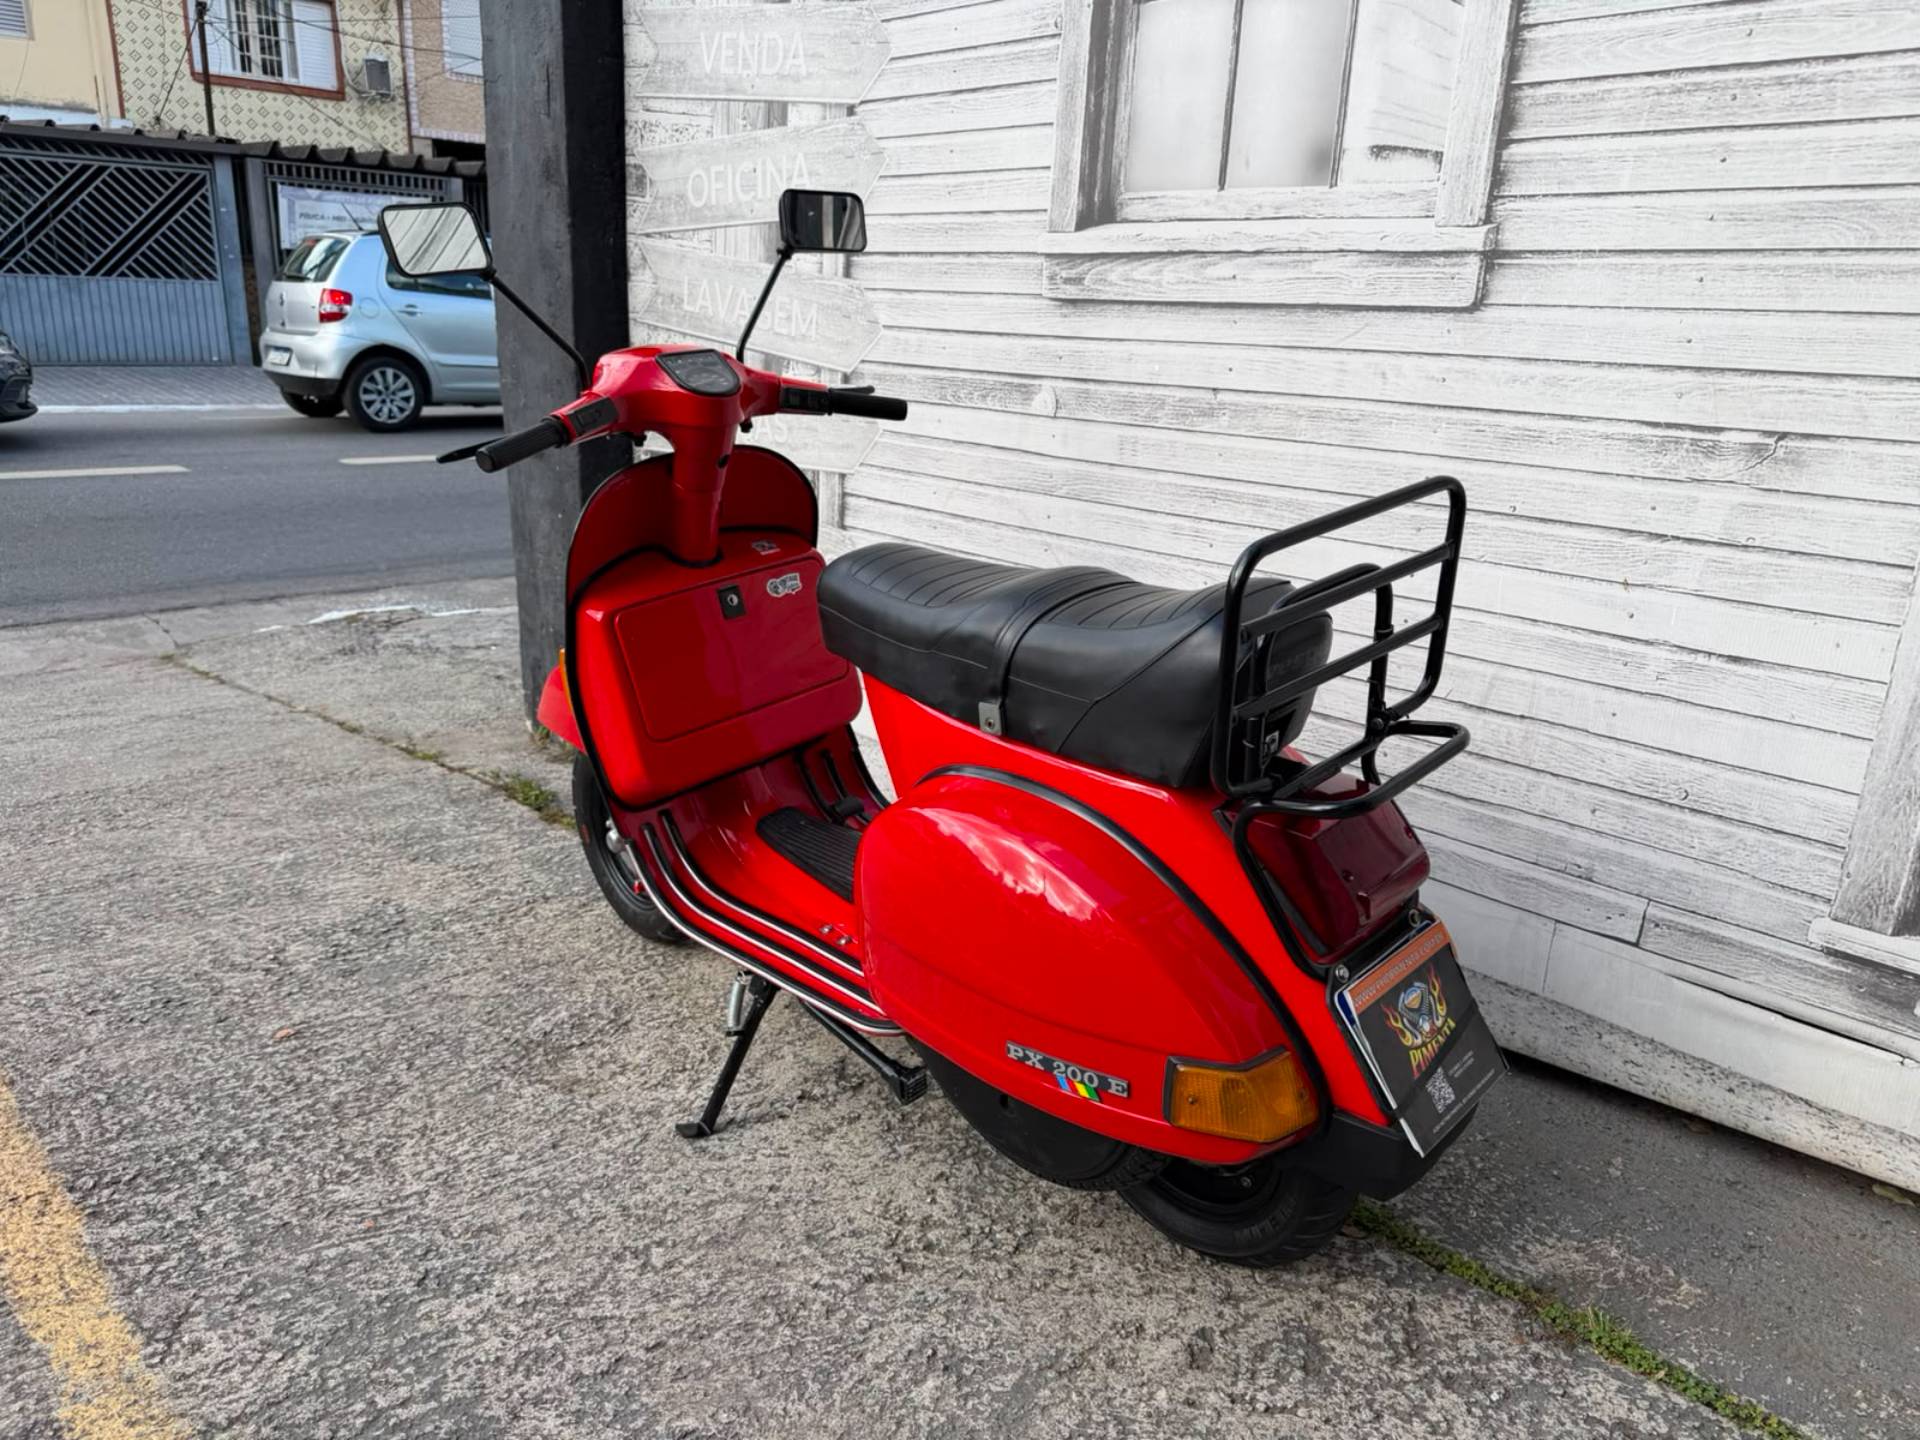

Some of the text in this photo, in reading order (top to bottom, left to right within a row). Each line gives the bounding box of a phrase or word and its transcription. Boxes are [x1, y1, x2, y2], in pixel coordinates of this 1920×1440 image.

[700, 31, 807, 77] VENDA
[687, 152, 811, 208] OFICINA
[1007, 1043, 1129, 1098] PX 200 E
